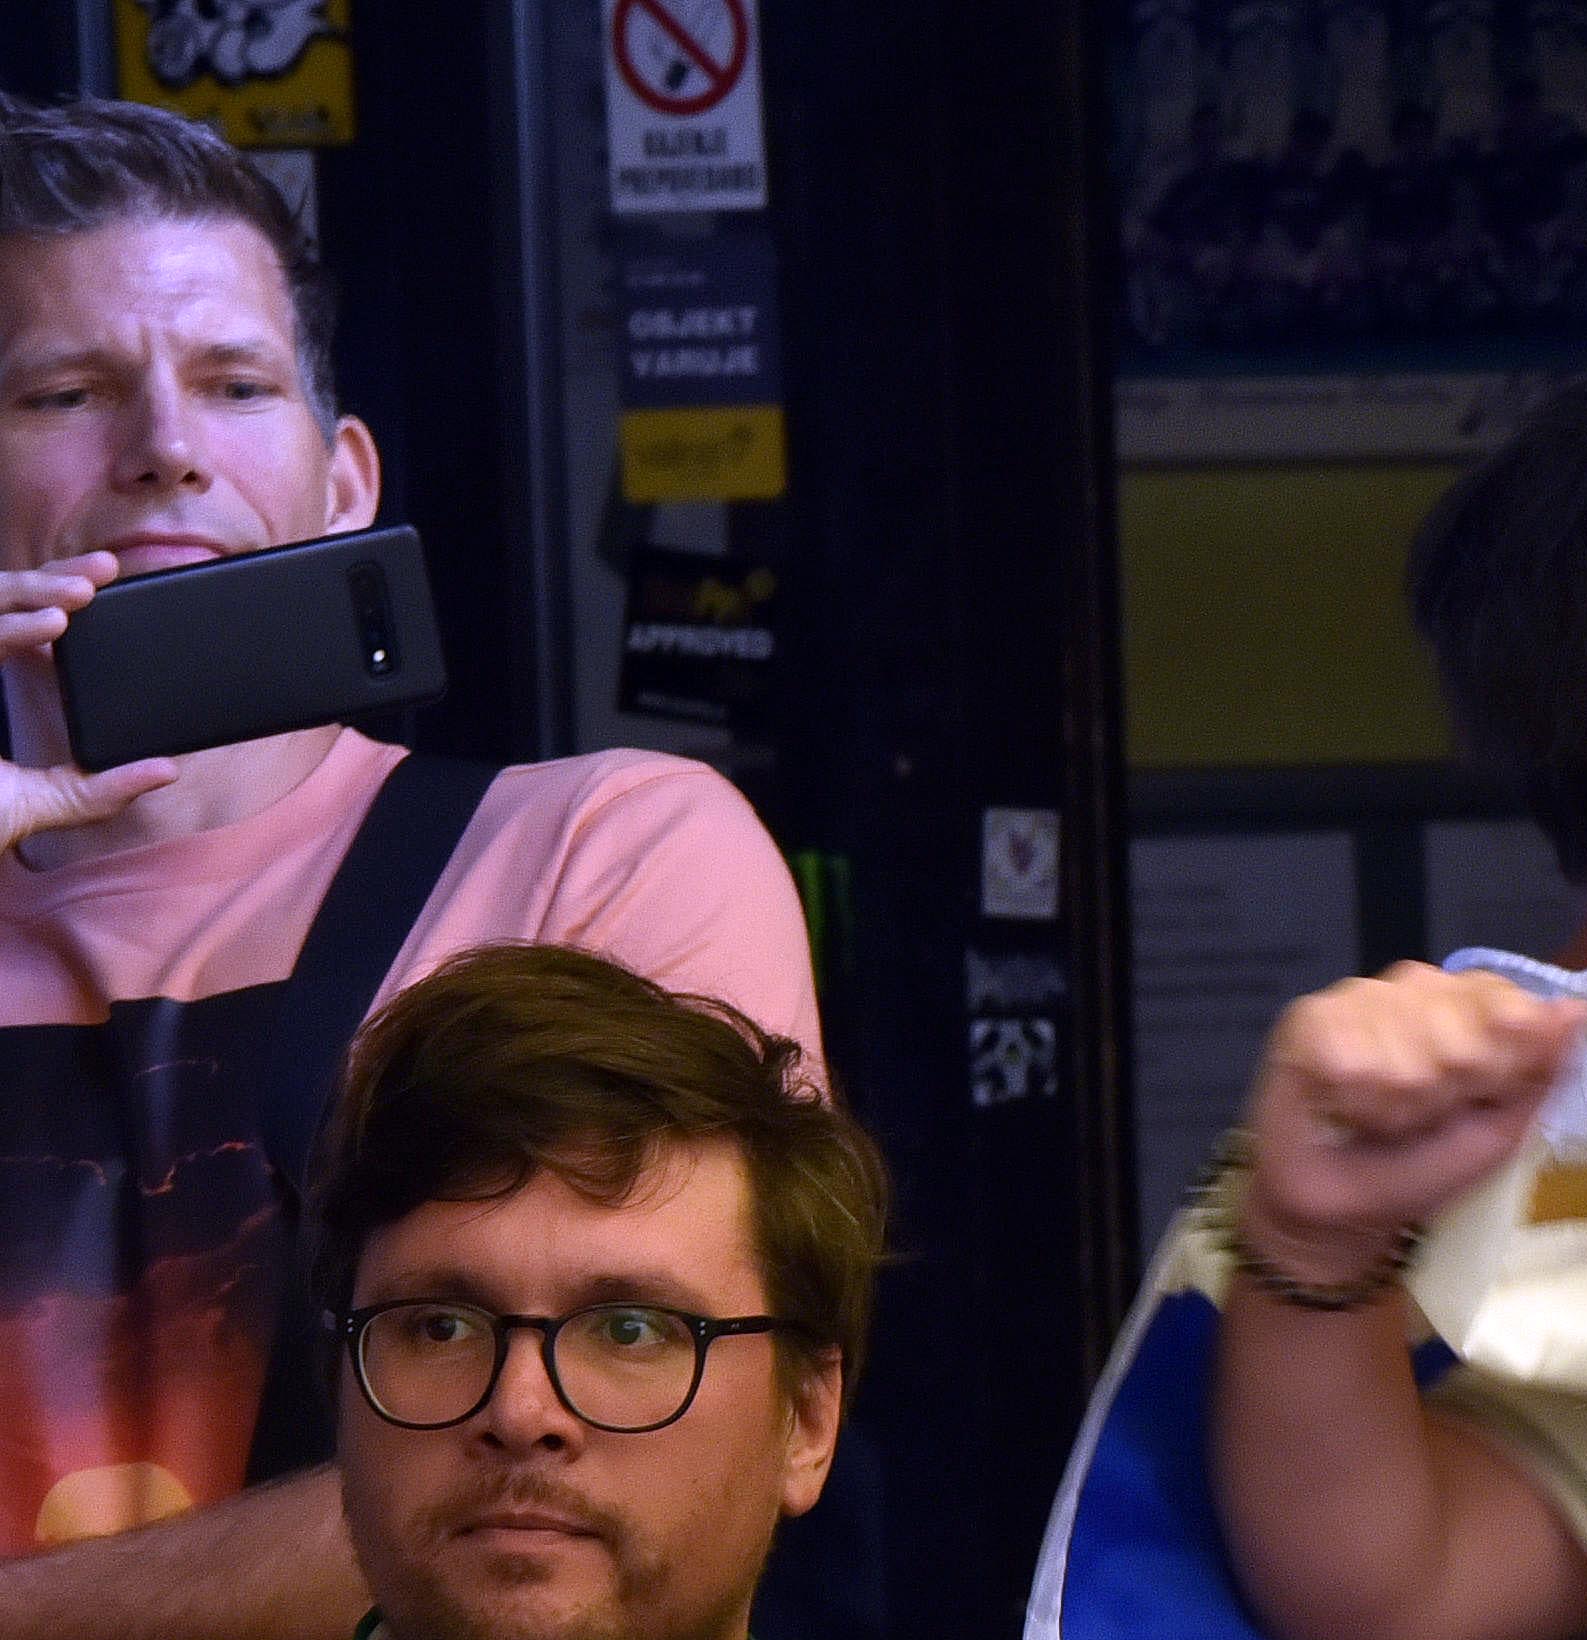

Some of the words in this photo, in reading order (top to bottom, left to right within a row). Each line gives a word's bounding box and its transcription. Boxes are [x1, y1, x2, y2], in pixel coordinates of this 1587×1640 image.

[628, 304, 757, 339] OBJEKT
[631, 345, 759, 379] VARUJE
[628, 622, 774, 660] APPROVED
